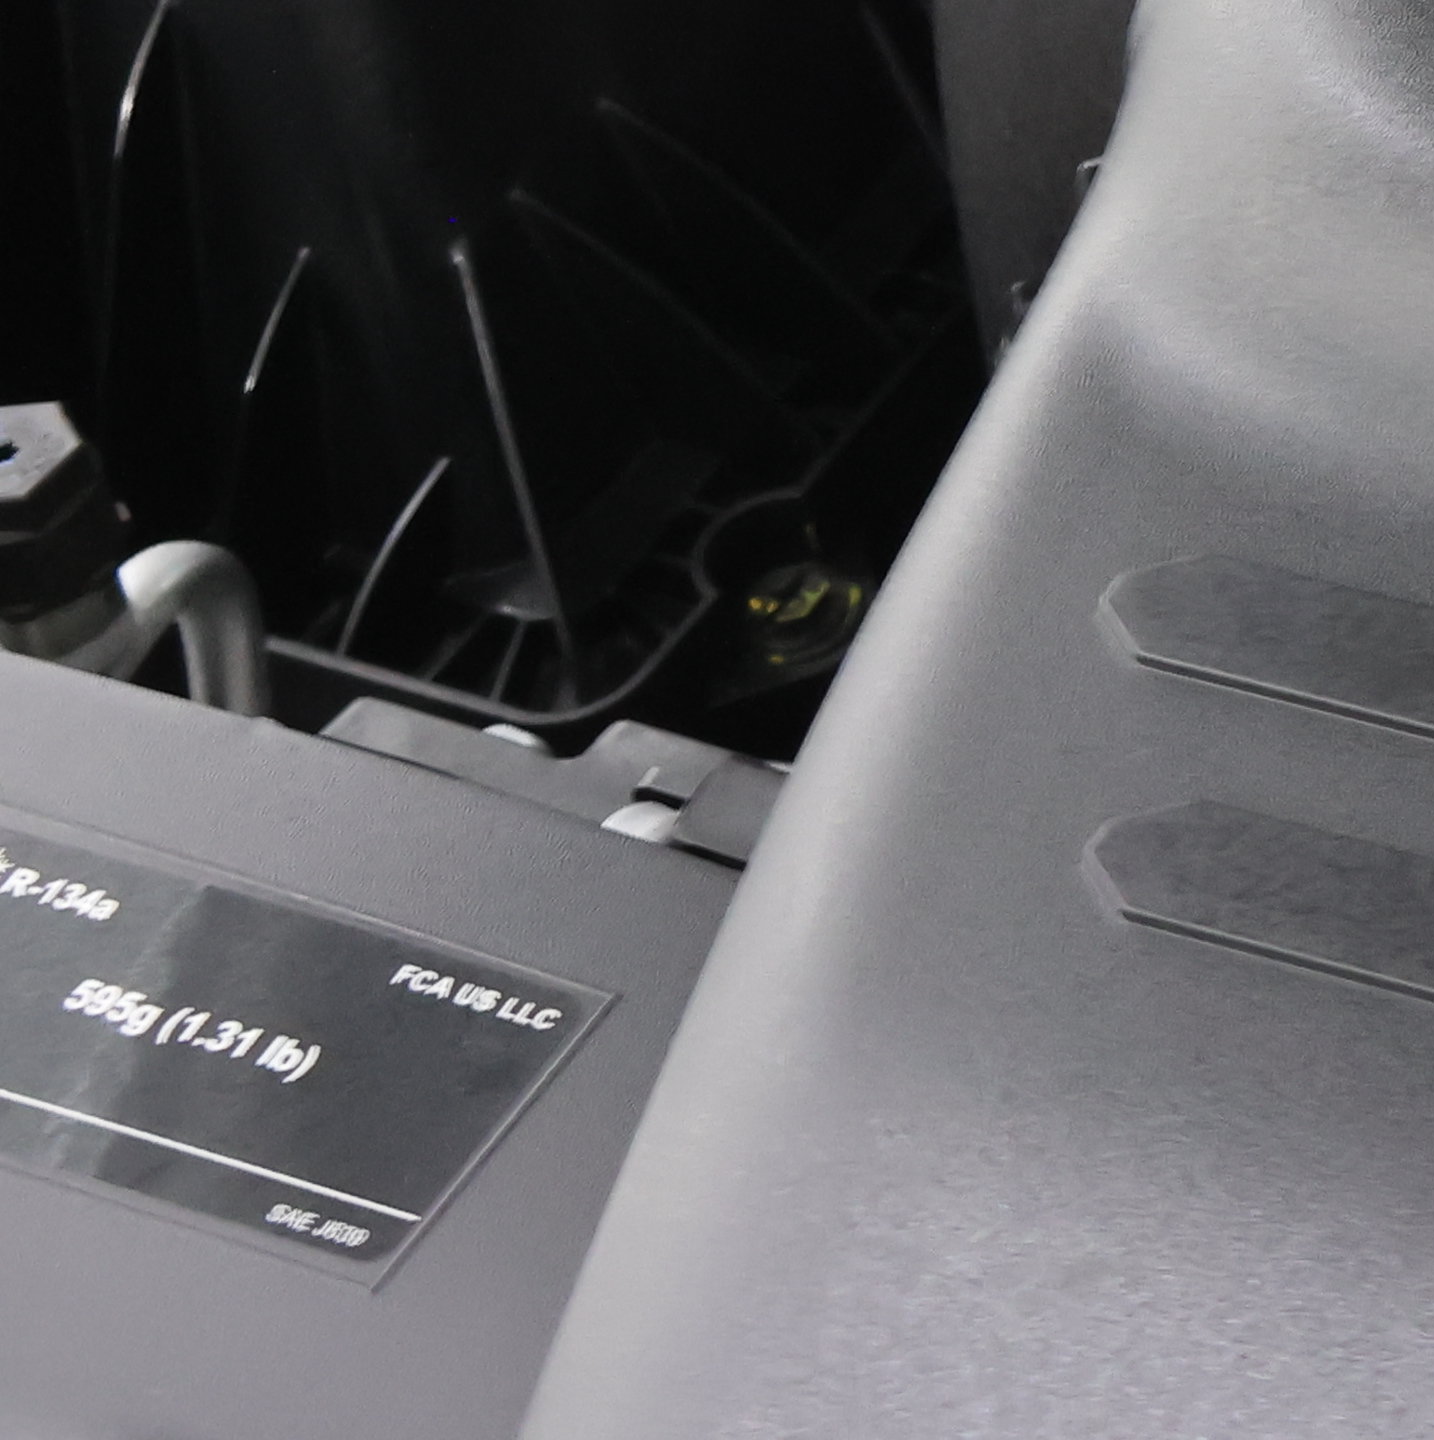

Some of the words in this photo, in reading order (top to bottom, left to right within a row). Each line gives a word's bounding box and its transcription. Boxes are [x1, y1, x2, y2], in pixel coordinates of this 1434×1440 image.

[0, 867, 120, 921] R-134a
[389, 964, 455, 1000] FCA
[452, 983, 502, 1012] US
[495, 997, 563, 1030] LLC
[63, 978, 165, 1037] 595g
[155, 1006, 265, 1059] (1.31
[254, 1035, 322, 1084] lb)
